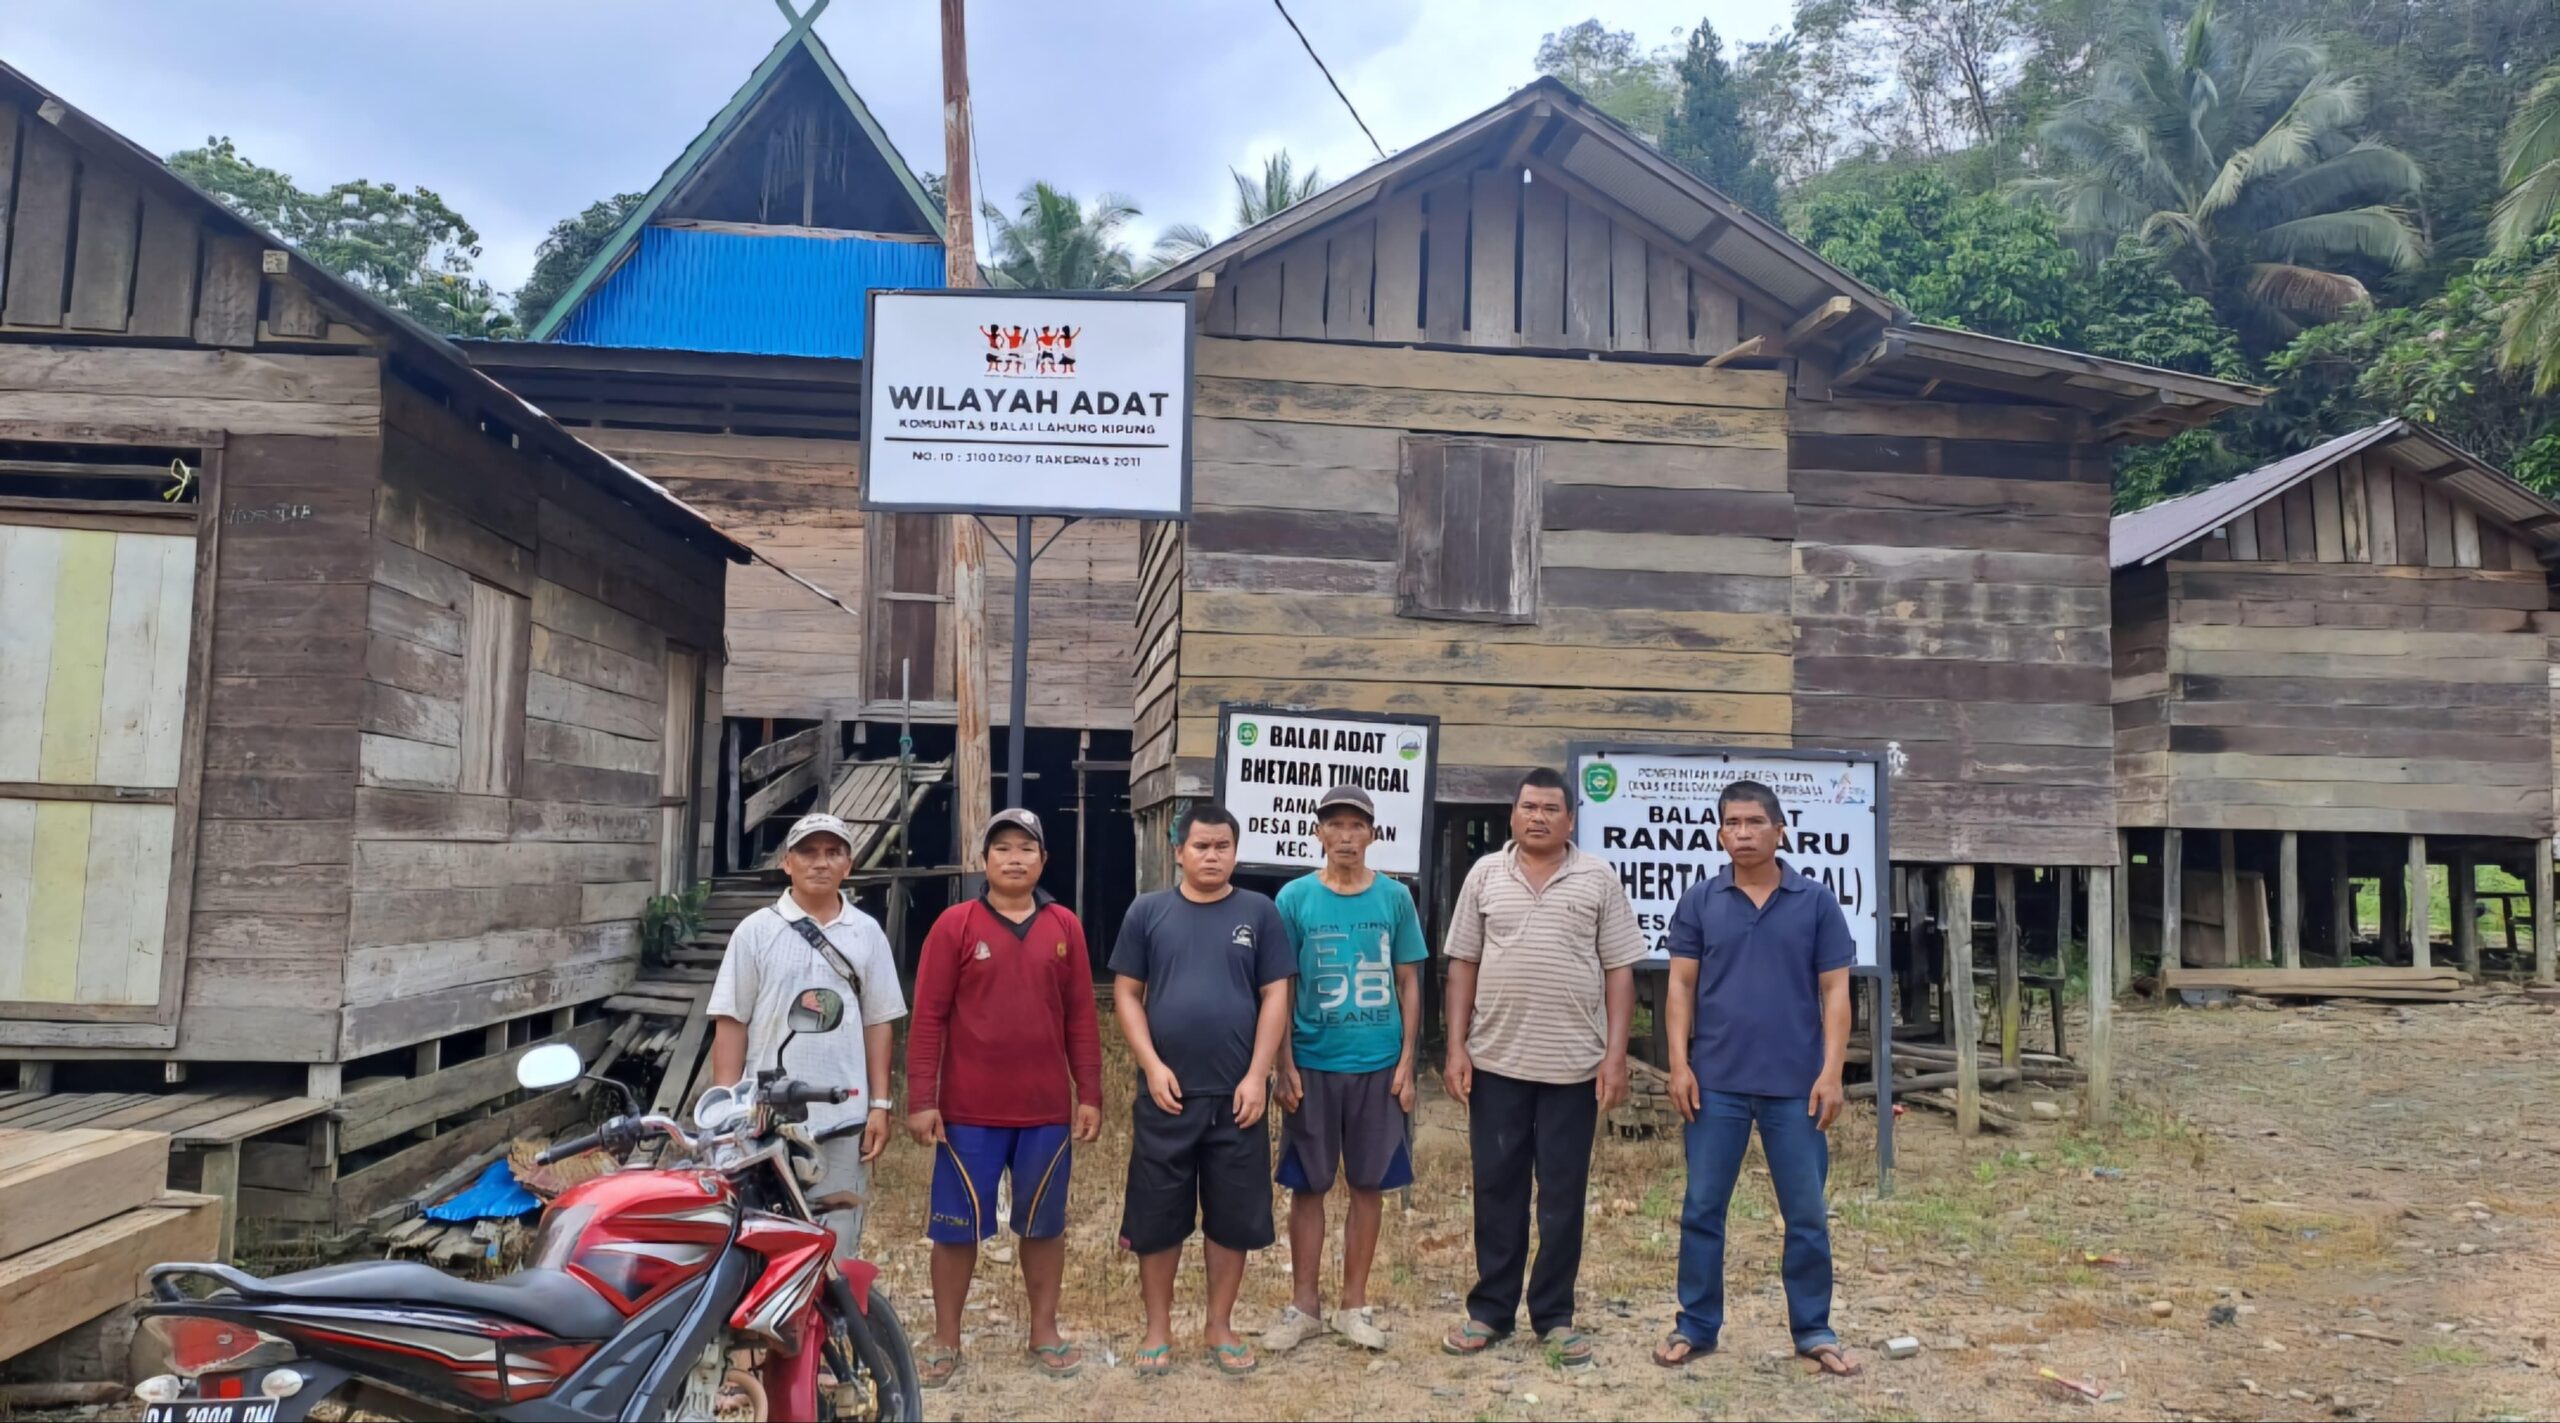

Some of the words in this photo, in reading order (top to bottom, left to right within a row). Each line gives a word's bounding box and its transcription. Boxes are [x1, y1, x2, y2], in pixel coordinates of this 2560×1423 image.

[888, 385, 1058, 414] WILAYAH
[1070, 390, 1169, 417] ADAT
[899, 419, 985, 431] KOMUNITAS
[990, 421, 1033, 431] BALAI
[1101, 424, 1156, 435] KIPUNG
[912, 451, 936, 461] NO.
[941, 453, 953, 462] ID
[1035, 454, 1110, 466] RAKERNAS
[1270, 725, 1329, 751] BALAI
[1334, 729, 1386, 754] ADAT
[1241, 758, 1322, 787] BHETARA
[1328, 763, 1410, 793] TUNGGAL
[1273, 797, 1318, 814] RANA
[1649, 805, 1717, 824] BALA
[1248, 817, 1290, 834] DESA
[1276, 840, 1313, 858] KEC.
[1779, 831, 1849, 855] ARU
[1312, 1009, 1390, 1024] JEANS
